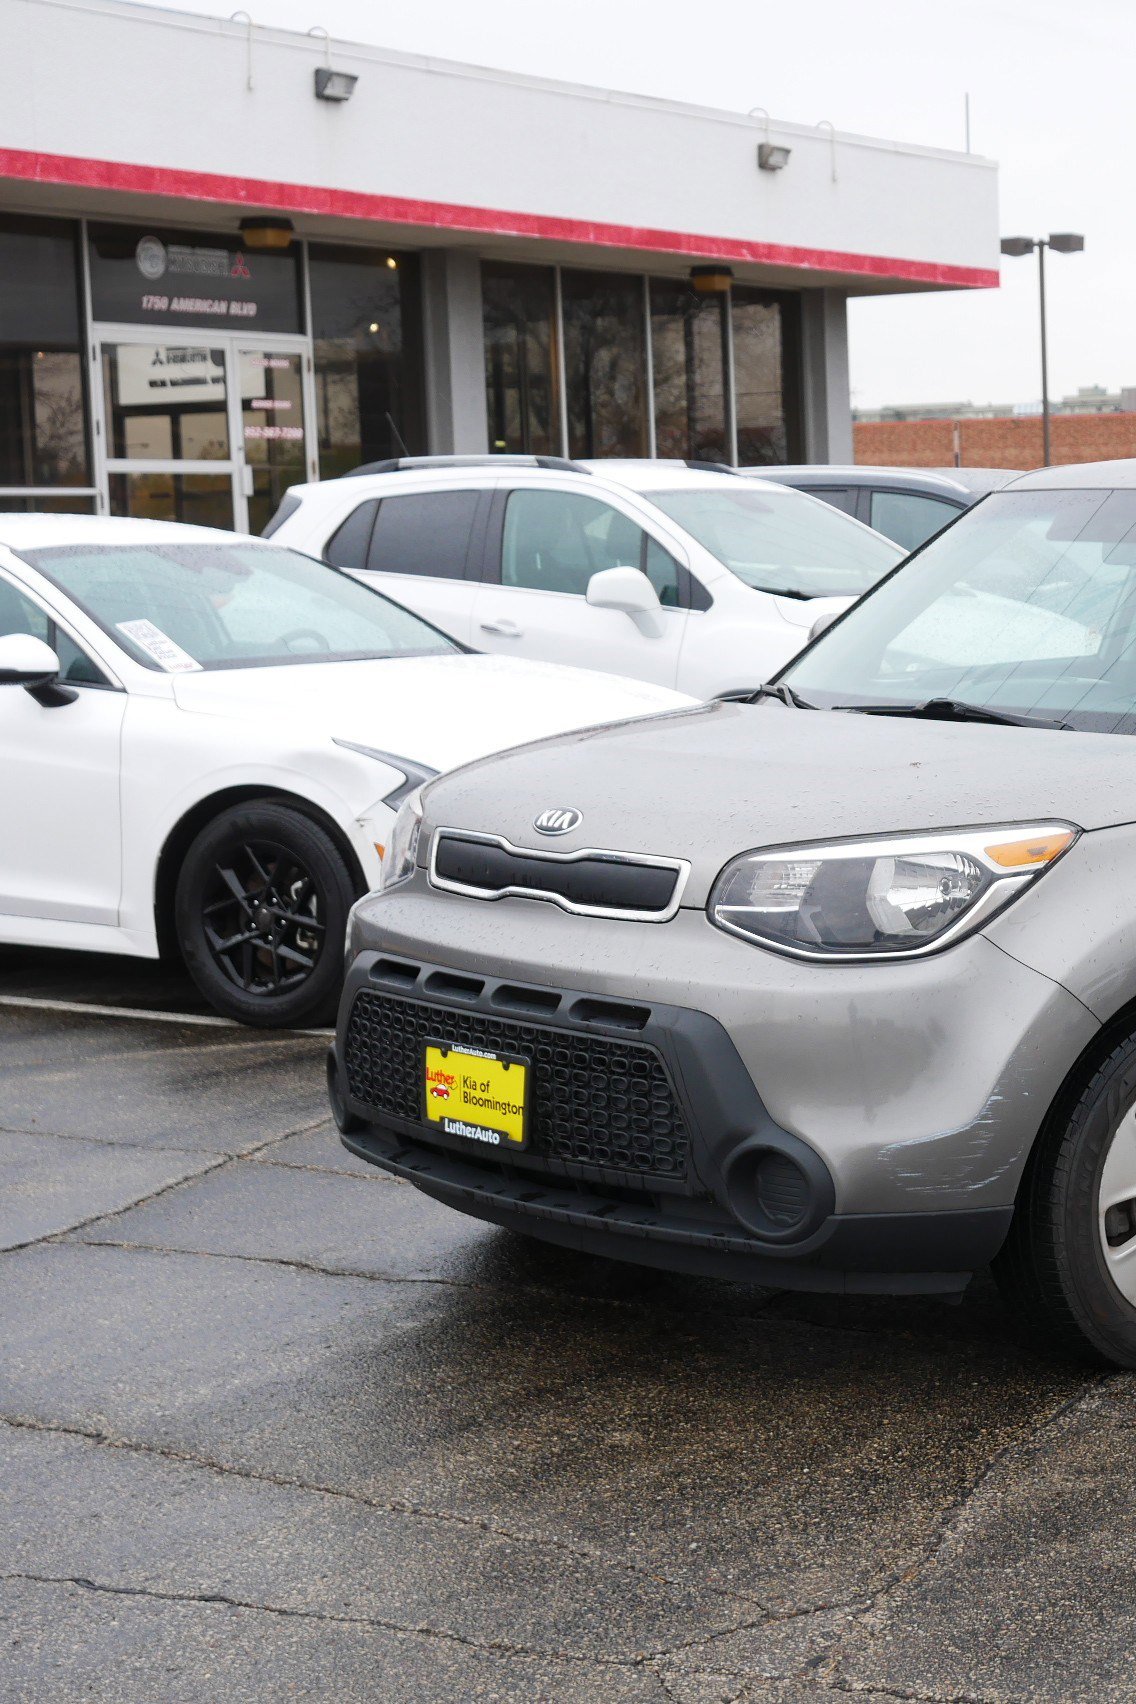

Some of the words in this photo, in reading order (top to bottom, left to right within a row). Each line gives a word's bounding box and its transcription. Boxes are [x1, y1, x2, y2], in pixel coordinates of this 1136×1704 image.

[170, 296, 228, 315] AMERICAN
[229, 300, 258, 318] BLVD
[536, 809, 574, 830] KIA
[452, 1044, 497, 1060] LutherAuto.com
[426, 1067, 454, 1085] Luther
[463, 1075, 477, 1090] Kia
[480, 1080, 490, 1093] of
[463, 1091, 525, 1116] Bloomington
[444, 1118, 500, 1145] LutherAuto
